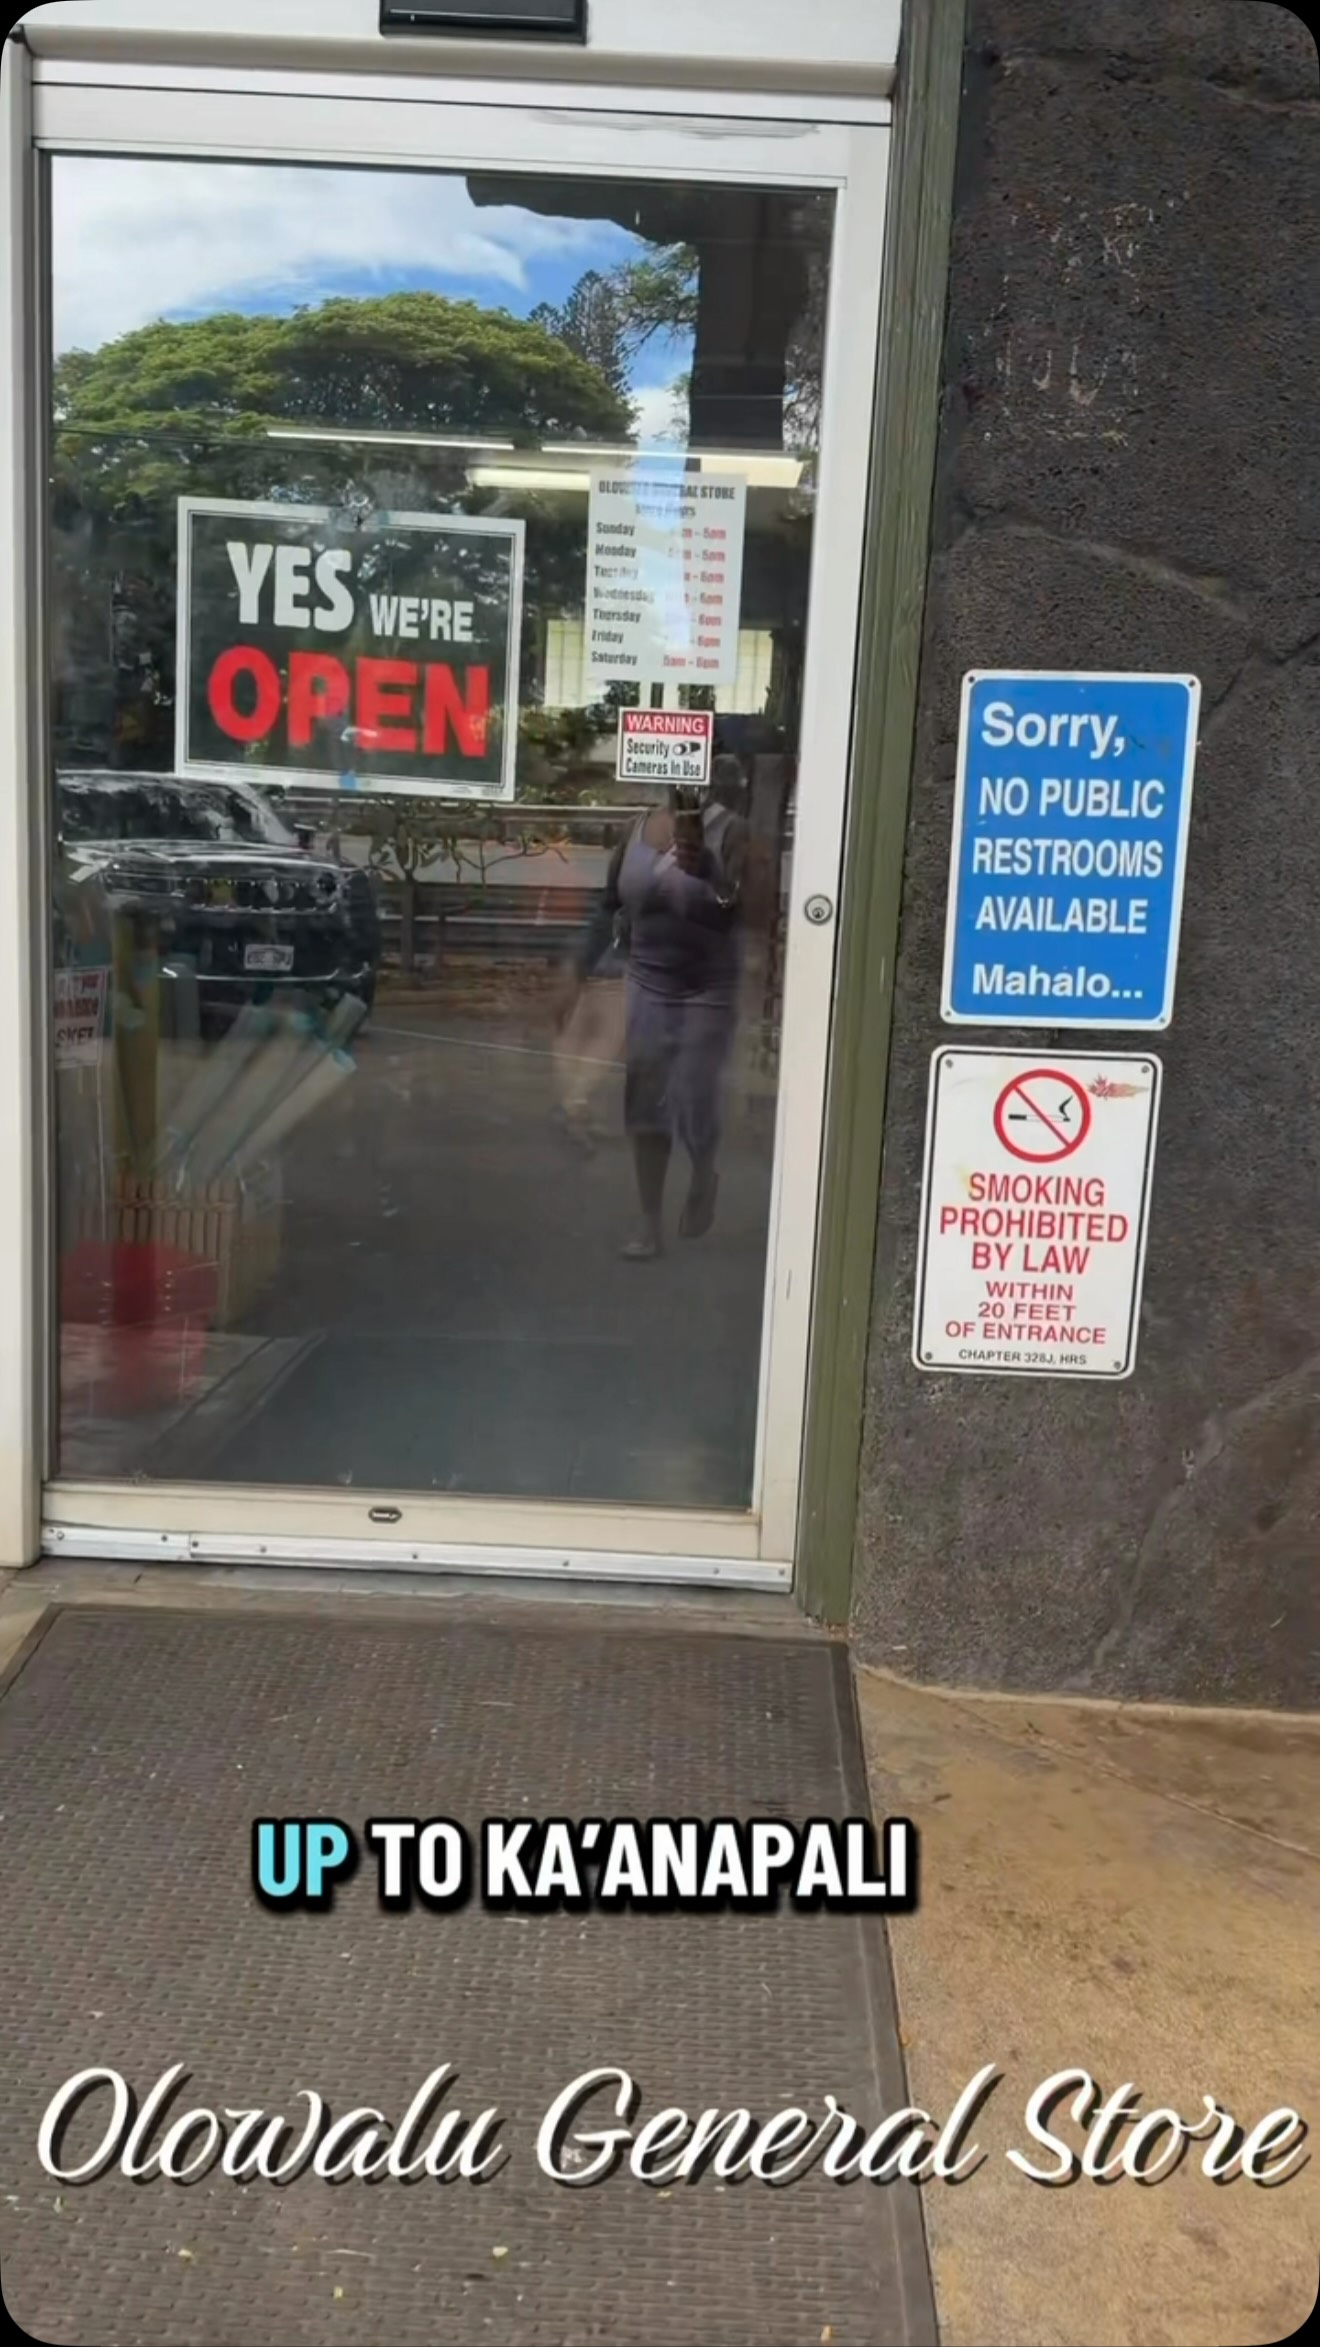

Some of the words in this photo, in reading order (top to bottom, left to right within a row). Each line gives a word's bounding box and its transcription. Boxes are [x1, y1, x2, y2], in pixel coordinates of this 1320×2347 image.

[700, 486, 736, 500] STORE
[596, 522, 635, 537] Sunday
[595, 544, 637, 558] Monday
[226, 541, 355, 632] YES
[370, 594, 475, 643] WE'RE
[591, 651, 638, 666] Saturday
[207, 644, 490, 758] OPEN
[626, 714, 705, 734] WARNING
[981, 701, 1126, 760] Sorry,
[626, 738, 670, 759] Security
[626, 757, 668, 775] Cameras
[670, 760, 681, 776] In
[683, 760, 700, 777] Use
[978, 776, 1029, 817] NO
[1039, 778, 1166, 819] PUBLIC
[972, 837, 1164, 878] RESTROOMS
[974, 895, 1149, 935] AVAILABLE
[972, 963, 1144, 999] Mahalo...
[968, 1172, 1105, 1208] SMOKING
[939, 1206, 1129, 1244] PROHIBITED
[971, 1242, 1013, 1271] BY
[1023, 1244, 1091, 1275] LAW
[985, 1280, 1074, 1301] WITHIN
[978, 1301, 1005, 1320] 20
[1013, 1302, 1076, 1322] FEET
[945, 1321, 976, 1339] OF
[982, 1322, 1106, 1345] ENTRANCE
[958, 1348, 1021, 1363] CHAPTER
[1059, 1353, 1087, 1366] HRS
